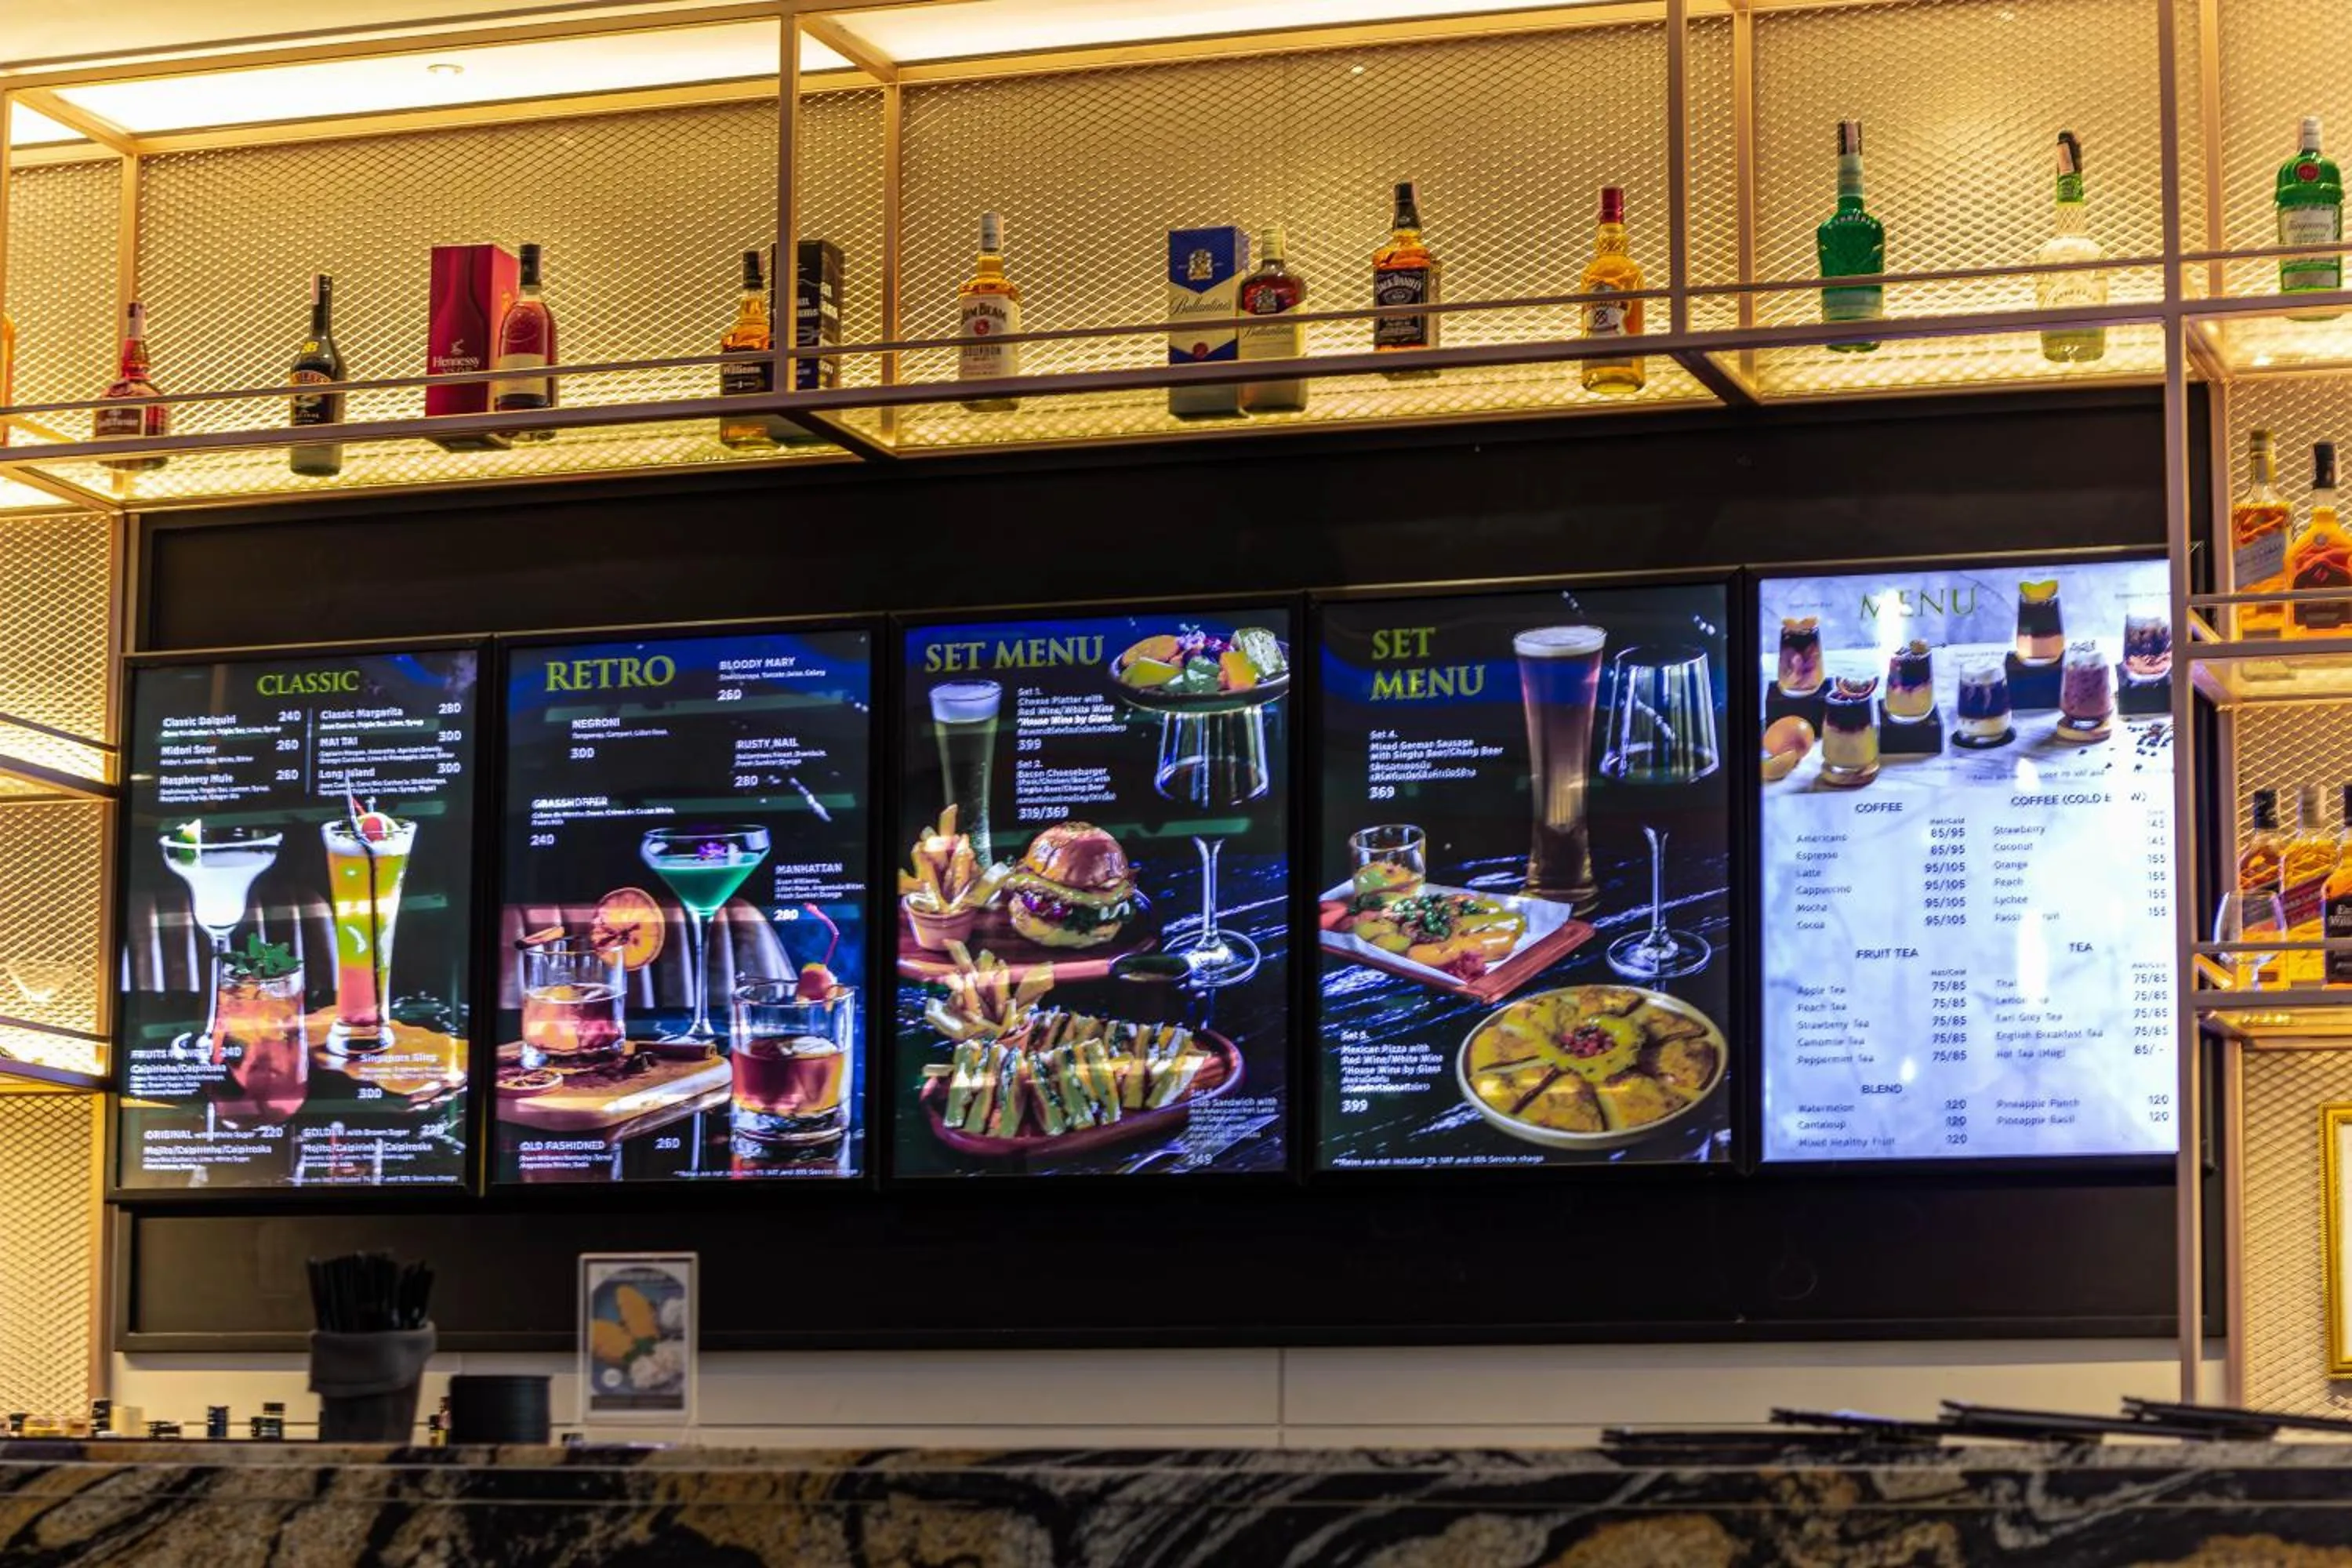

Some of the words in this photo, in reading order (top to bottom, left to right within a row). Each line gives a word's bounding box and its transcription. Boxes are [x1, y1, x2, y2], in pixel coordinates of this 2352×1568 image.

[433, 357, 480, 368] Hennessy
[1372, 626, 1436, 660] SET
[924, 641, 985, 673] SET
[994, 635, 1105, 669] MENU
[719, 659, 762, 670] BLOODY
[765, 657, 796, 667] MARY
[545, 655, 675, 691] RETRO
[257, 670, 360, 696] CLASSIC
[1370, 664, 1485, 701] MENU
[278, 710, 302, 722] 240
[572, 718, 620, 729] NEGRONI
[735, 739, 771, 750] RUSTY
[772, 738, 800, 748] NAIL
[1018, 739, 1042, 750] 399
[569, 748, 594, 759] 300
[1369, 786, 1395, 800] 369
[532, 797, 608, 808] GRASSHOPPER
[2010, 793, 2060, 807] COFFEE
[2062, 793, 2101, 805] (COLD
[1855, 802, 1903, 814] COFFEE
[1994, 826, 2045, 835] Strawberry
[530, 834, 554, 846] 240
[1796, 834, 1847, 843] Americano
[1994, 843, 2033, 851] Coconut
[1796, 851, 1838, 861] Espresso
[775, 862, 843, 874] MANHATTAN
[1925, 863, 1965, 873] 95/105
[1994, 860, 2028, 870] Orange
[1925, 880, 1965, 891] 95/105
[1994, 877, 2024, 886] Peach
[1796, 886, 1852, 895] Cappuccino
[1925, 898, 1966, 908] 95/105
[1994, 896, 2028, 906] Lychee
[1796, 903, 1828, 912] Mocha
[1796, 920, 1825, 929] Cocoa
[1925, 915, 1966, 926] 95/105
[2069, 942, 2094, 953] TEA
[1856, 949, 1891, 959] FRUIT
[1895, 948, 1919, 958] TEA
[1797, 986, 1825, 996] Apple
[1933, 981, 1967, 992] 75/85
[1933, 998, 1967, 1009] 75/85
[1933, 1016, 1967, 1027] 75/85
[1995, 1014, 2016, 1022] Earl
[2019, 1014, 2041, 1023] Grey
[2046, 1012, 2063, 1021] Tea
[1798, 1021, 1849, 1030] Strawberry
[1853, 1019, 1870, 1028] Tea
[1848, 1036, 1865, 1045] Tea
[1933, 1033, 1967, 1044] 75/85
[1996, 1031, 2031, 1041] English
[2035, 1029, 2082, 1039] Breakfast
[2087, 1029, 2103, 1037] Tea
[1381, 1044, 1407, 1054] Pizza
[1797, 1055, 1853, 1066] Peppermint
[1858, 1054, 1875, 1062] Tea
[1933, 1050, 1967, 1062] 75/85
[1861, 1084, 1903, 1094] BLEND
[1945, 1100, 1967, 1110] 120
[1996, 1099, 2045, 1110] Pineapple
[2050, 1098, 2080, 1107] Punch
[2148, 1094, 2169, 1105] 120
[1341, 1100, 1368, 1112] 399
[1798, 1104, 1854, 1112] Watermelon
[1946, 1116, 1967, 1127] 120
[1996, 1116, 2045, 1126] Pineapple
[2050, 1115, 2075, 1123] Basil
[2149, 1112, 2169, 1121] 120
[144, 1131, 193, 1140] ORIGINAL
[1946, 1134, 1968, 1145] 120
[519, 1141, 543, 1152] OLD
[545, 1140, 605, 1151] FASHIONED
[1798, 1138, 1828, 1147] Mixed
